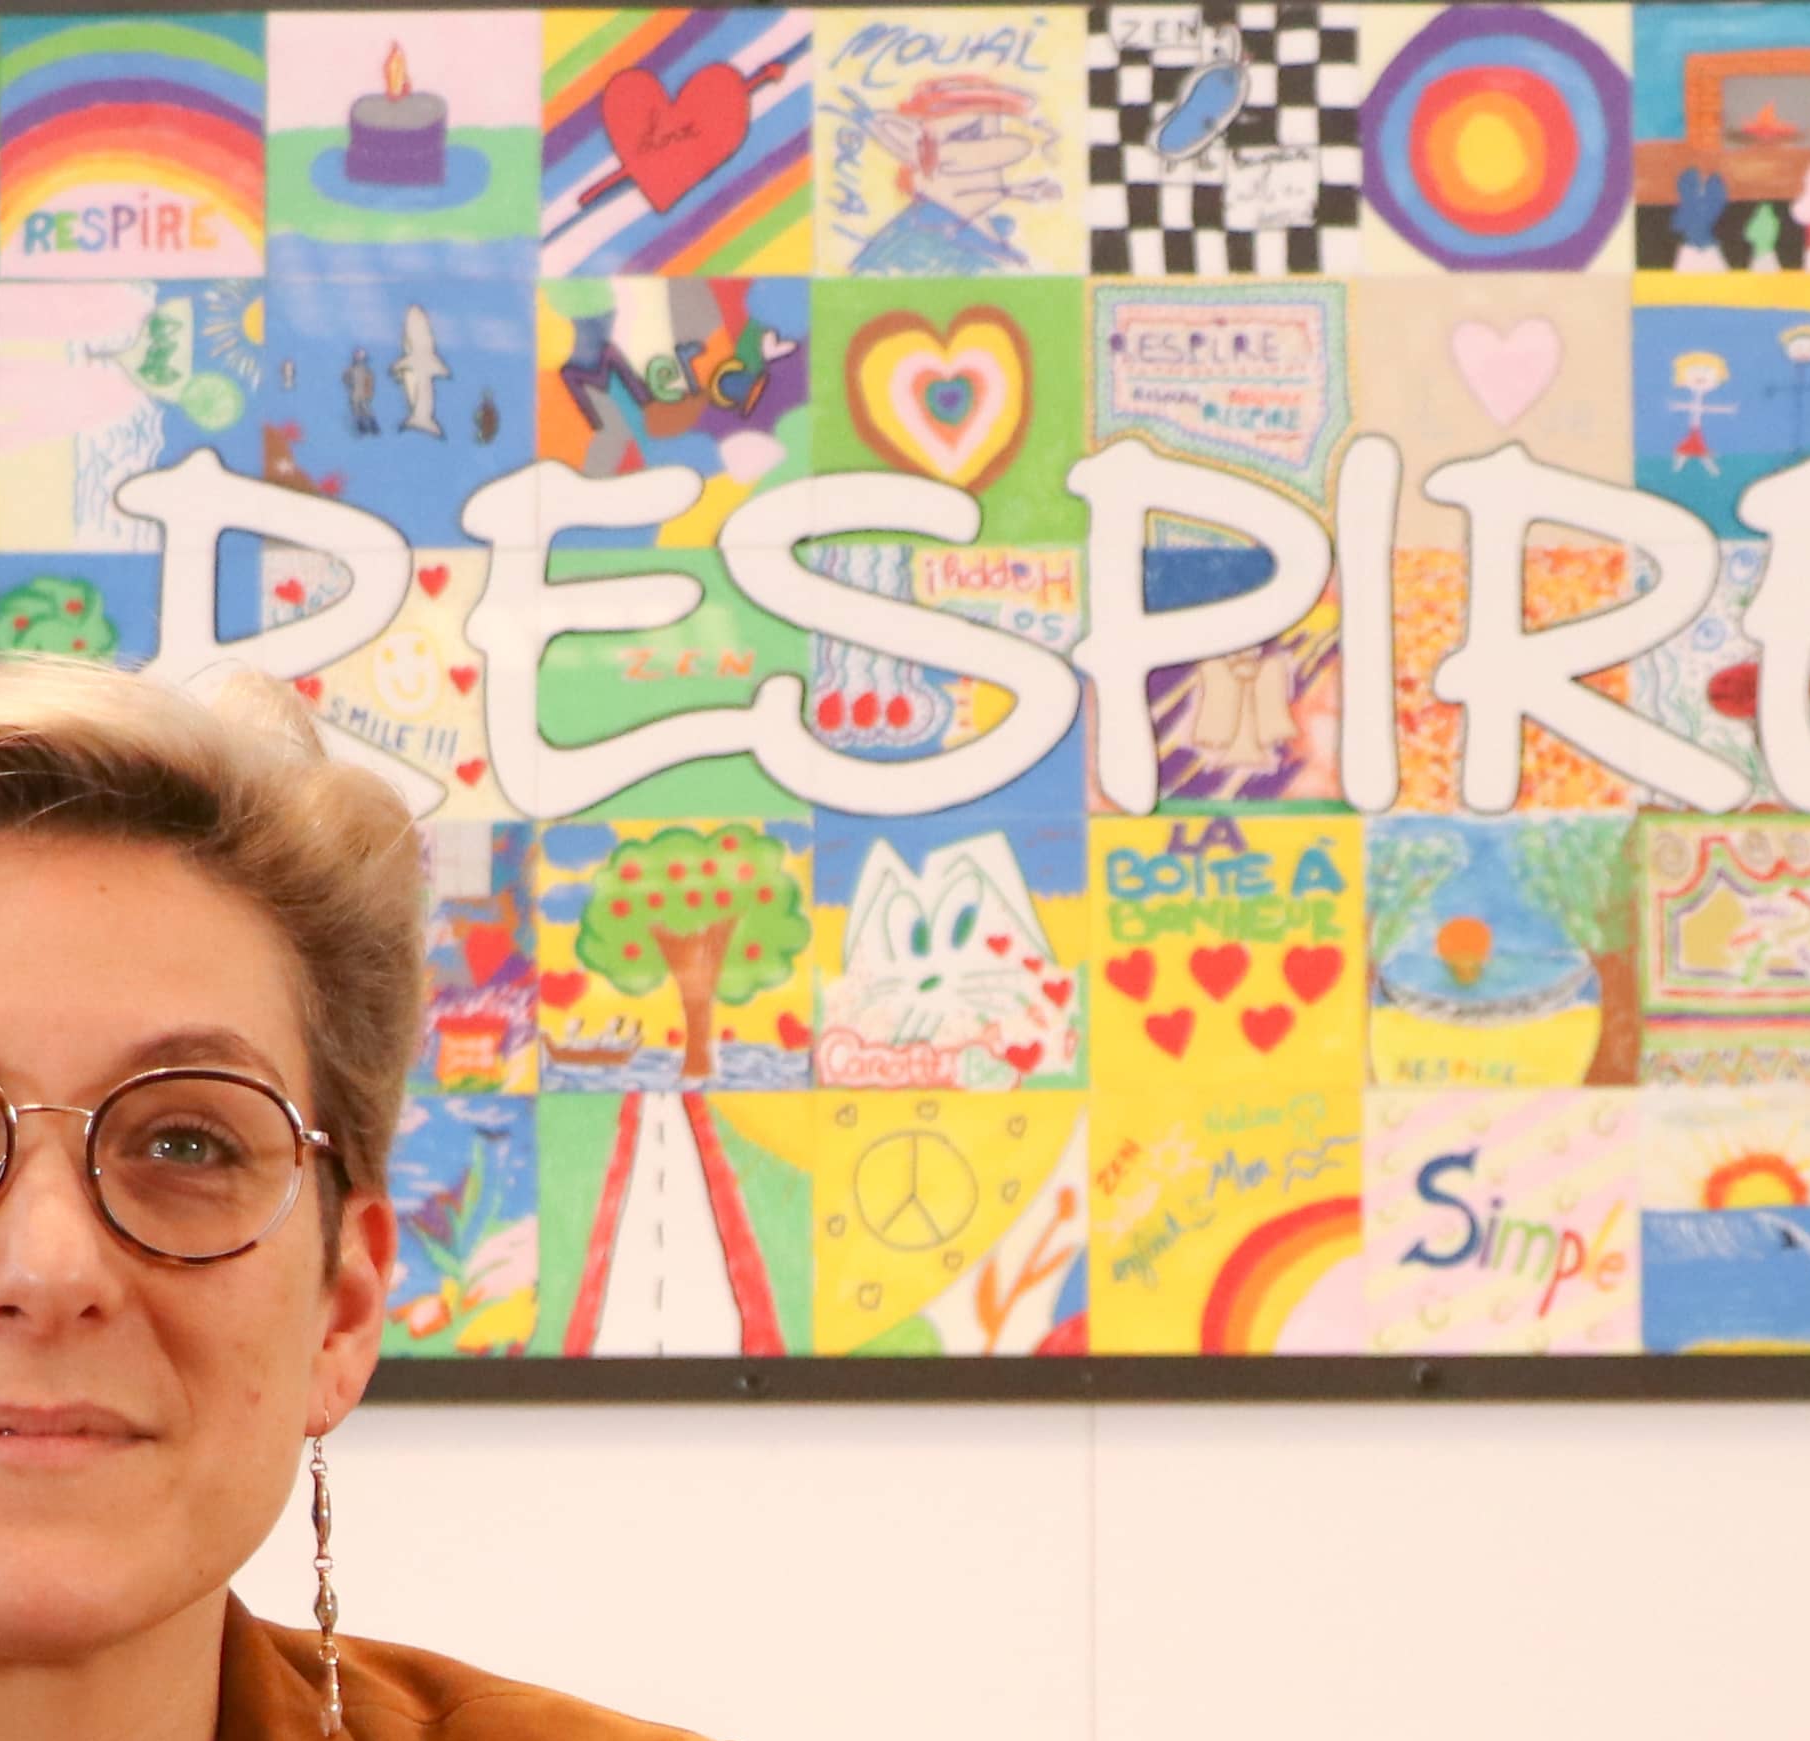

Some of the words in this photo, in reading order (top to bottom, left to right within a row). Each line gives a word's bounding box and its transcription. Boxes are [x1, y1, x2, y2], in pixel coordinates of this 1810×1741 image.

[1119, 19, 1200, 45] ZEN
[1110, 328, 1280, 364] RESPIRE
[616, 646, 756, 682] ZEN
[327, 697, 414, 750] SMILE
[1166, 816, 1249, 856] LA
[1107, 893, 1345, 943] BONHEUR
[1399, 1147, 1627, 1318] Simple
